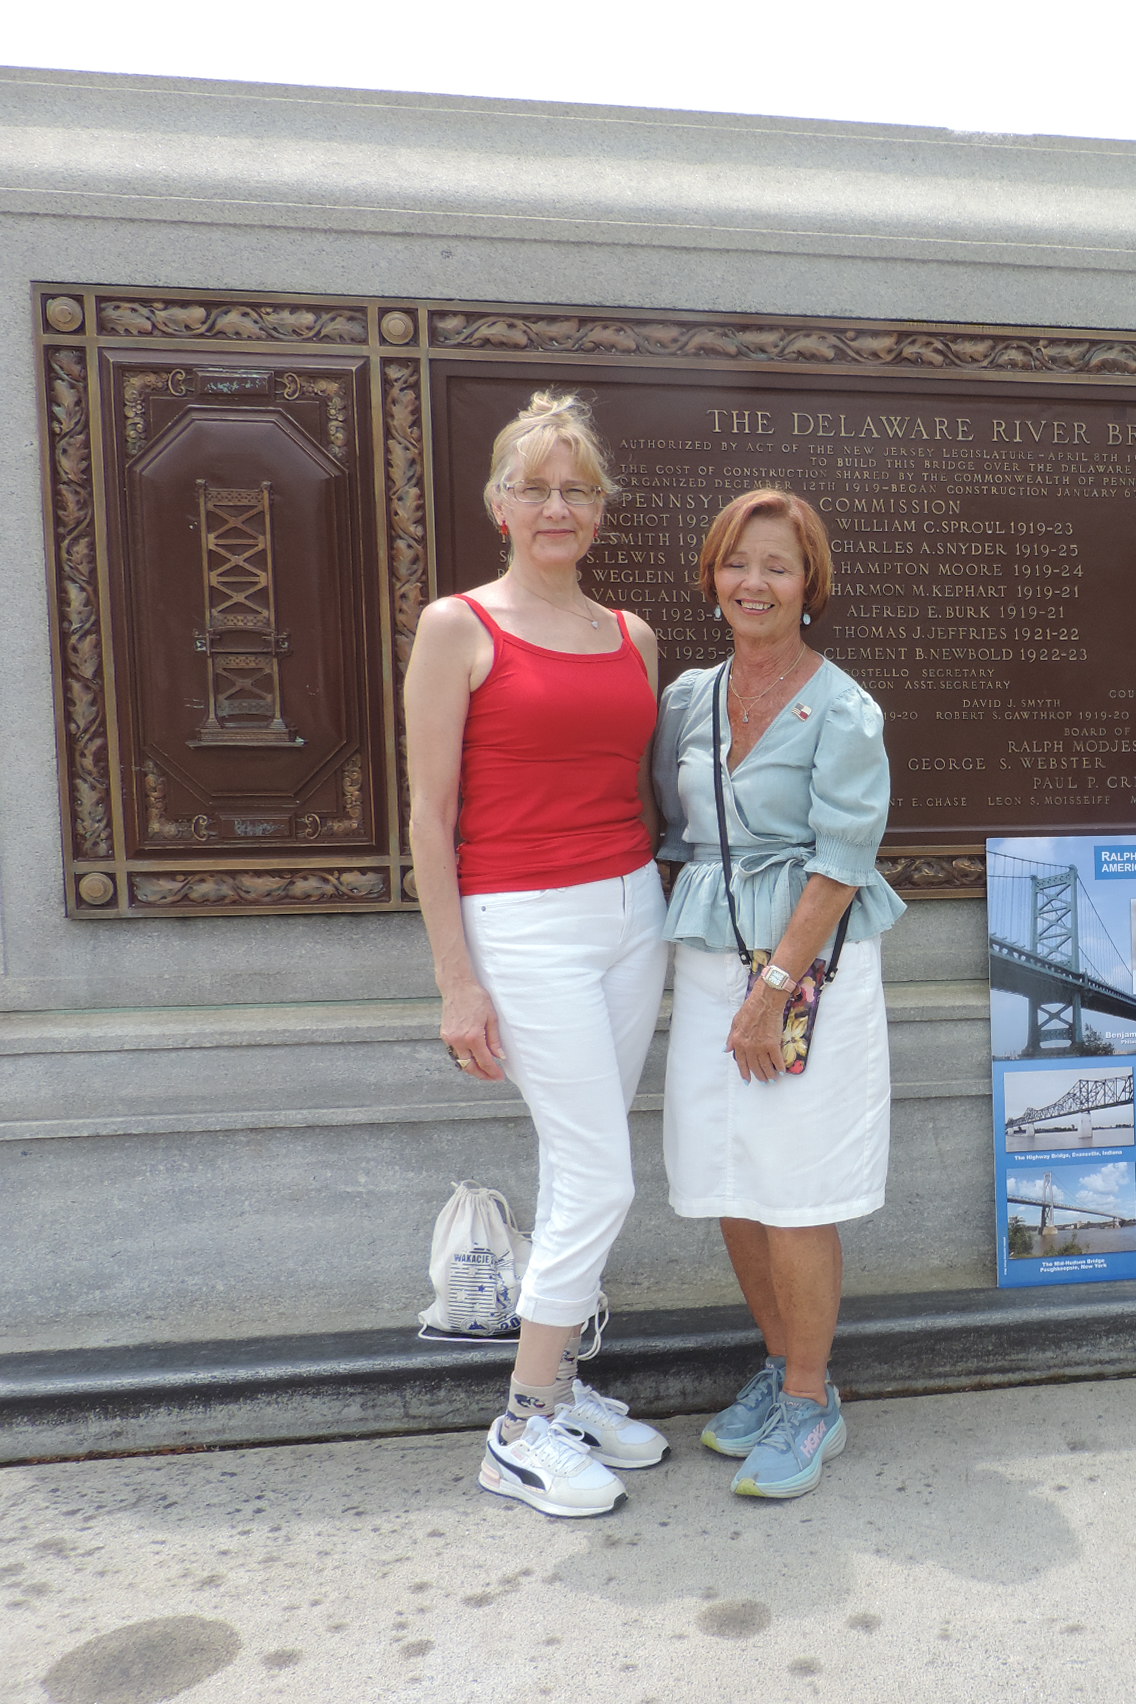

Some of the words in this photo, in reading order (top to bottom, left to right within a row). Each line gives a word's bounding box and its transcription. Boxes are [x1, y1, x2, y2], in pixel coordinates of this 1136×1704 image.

[707, 409, 774, 434] THE
[791, 411, 974, 441] DELAWARE
[991, 419, 1090, 444] RIVER
[619, 463, 648, 474] THE
[655, 465, 690, 474] COST
[697, 465, 715, 476] OF
[723, 466, 827, 478] CONSTRUCTION
[835, 469, 889, 480] SHARED
[898, 471, 914, 480] BY
[921, 472, 947, 482] THE
[953, 473, 1069, 485] COMMONWEALTH
[1077, 475, 1094, 485] OF
[818, 497, 960, 514] COMMISSION
[847, 604, 920, 618] ALFRED
[945, 605, 990, 618] BURK
[999, 606, 1065, 619] 1919-21
[962, 699, 1000, 708] DAVID
[1020, 699, 1061, 708] SMYTH
[1063, 726, 1106, 736] BOARD
[1114, 726, 1130, 736] OF
[1007, 740, 1063, 752] RALPH
[907, 757, 986, 770] GEORGE
[1019, 757, 1106, 768] WEBSTER
[1032, 777, 1077, 789] PAUL
[454, 1253, 489, 1263] WAKACJE
[800, 1419, 827, 1458] HOKA
